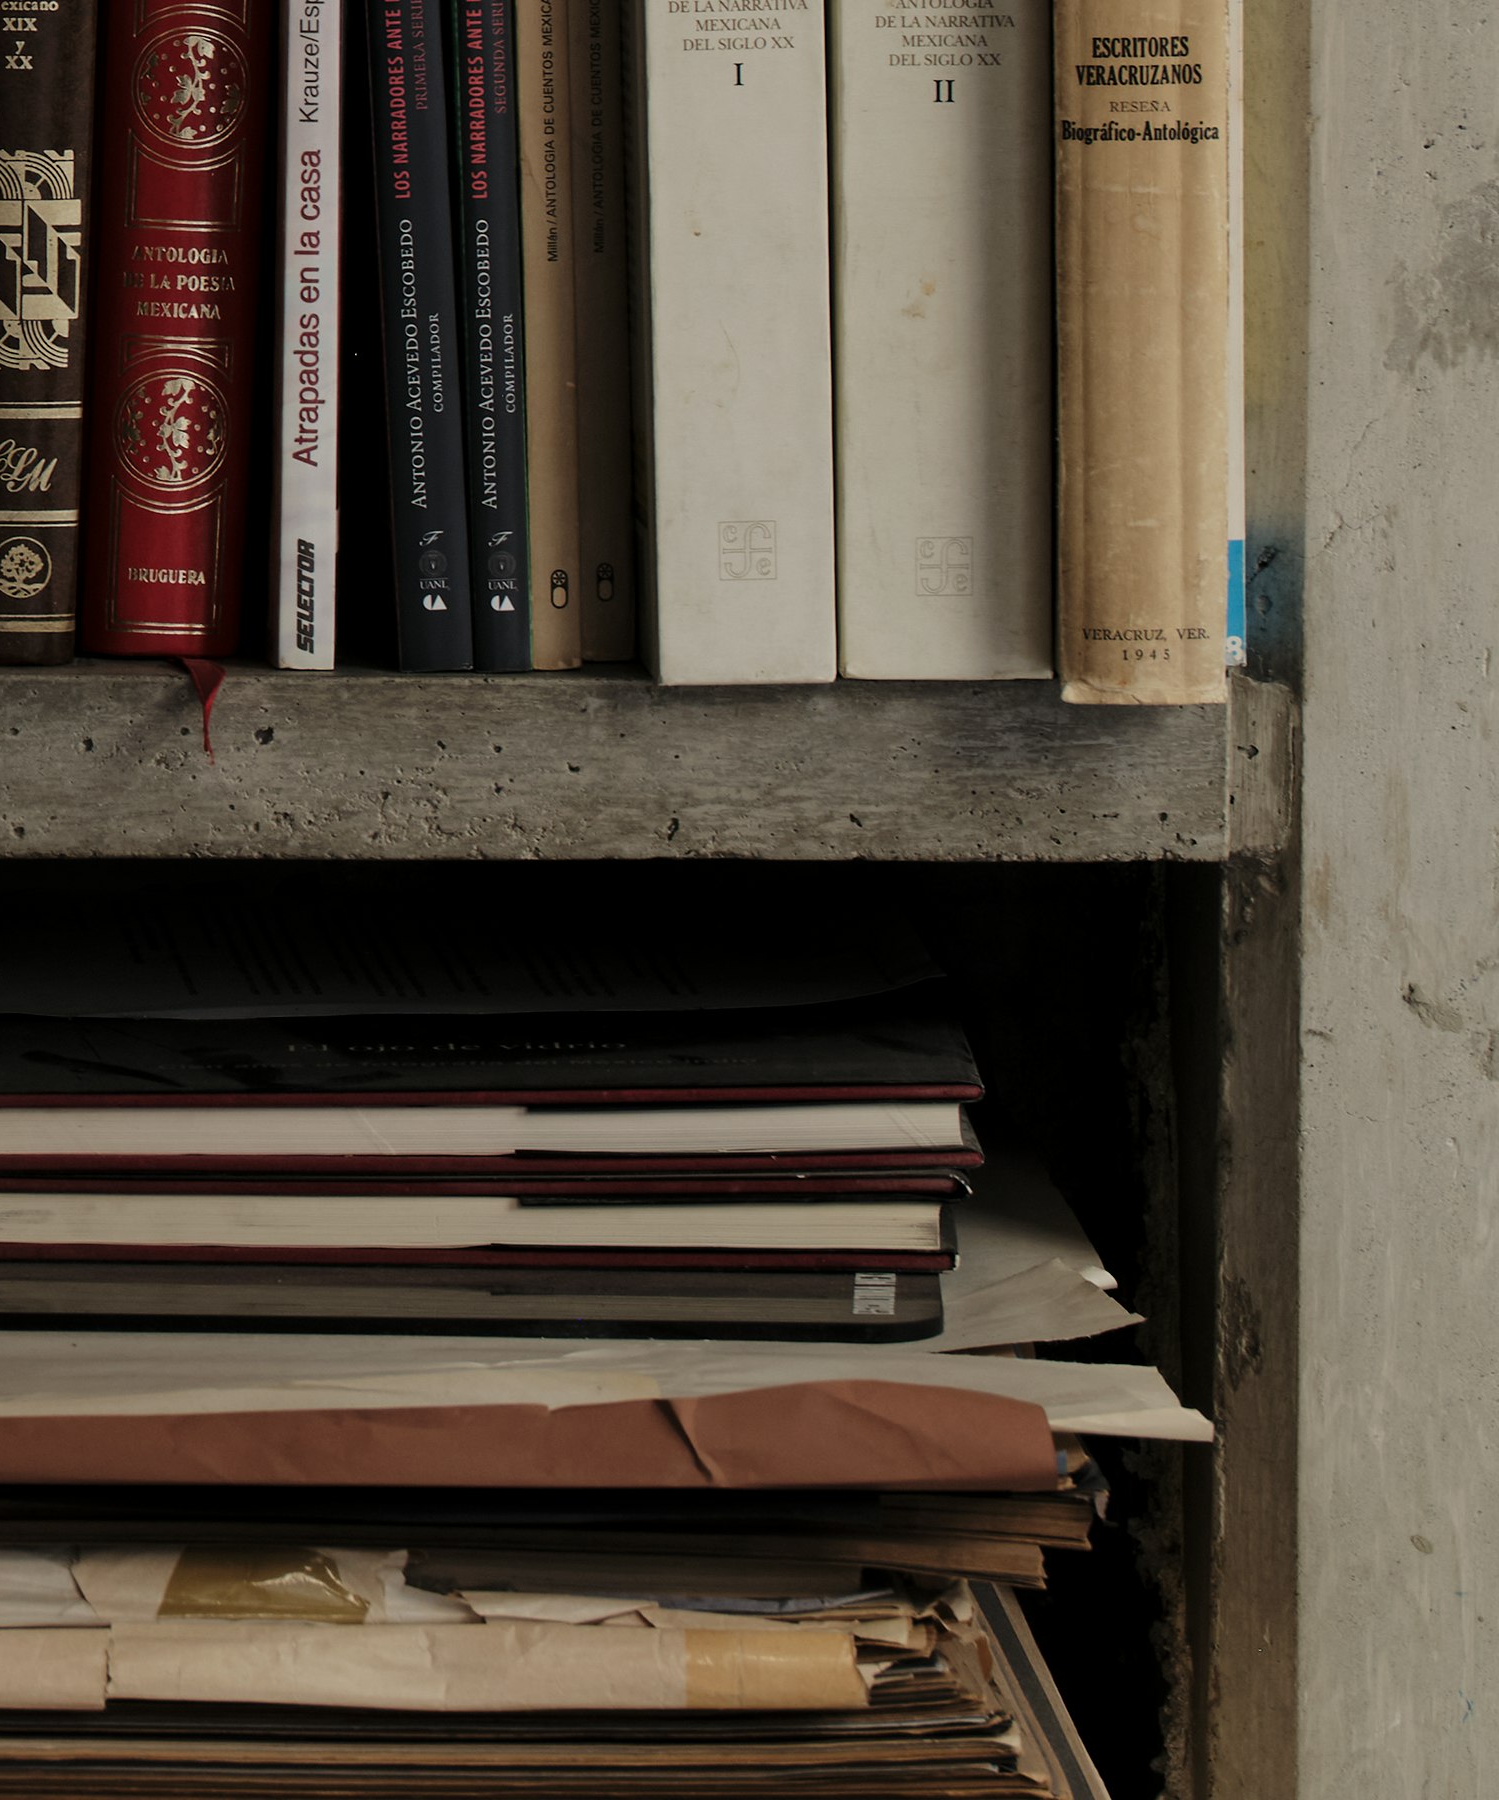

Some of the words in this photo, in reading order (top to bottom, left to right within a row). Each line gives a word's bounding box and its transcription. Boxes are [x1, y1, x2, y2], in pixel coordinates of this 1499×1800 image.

[668, 1, 690, 13] DE
[693, 0, 714, 13] LA
[2, 17, 38, 31] XIX
[695, 18, 781, 31] MEXICANA
[15, 41, 25, 55] y
[682, 38, 714, 51] DEL
[718, 37, 767, 50] SIGLO
[770, 36, 795, 49] XX
[1092, 36, 1189, 58] ESCRITORES
[4, 55, 34, 70] XX
[733, 63, 744, 86] I
[1075, 64, 1203, 86] VERACRUZANOS
[1110, 100, 1171, 113] RESEÑA
[1061, 120, 1219, 144] Biográfico-Antológica
[299, 150, 320, 221] casa
[294, 231, 319, 256] la
[300, 268, 319, 303] en
[292, 313, 325, 467] Atrapadas
[128, 568, 206, 585] BRUGUERA
[297, 539, 314, 654] SELECTOR
